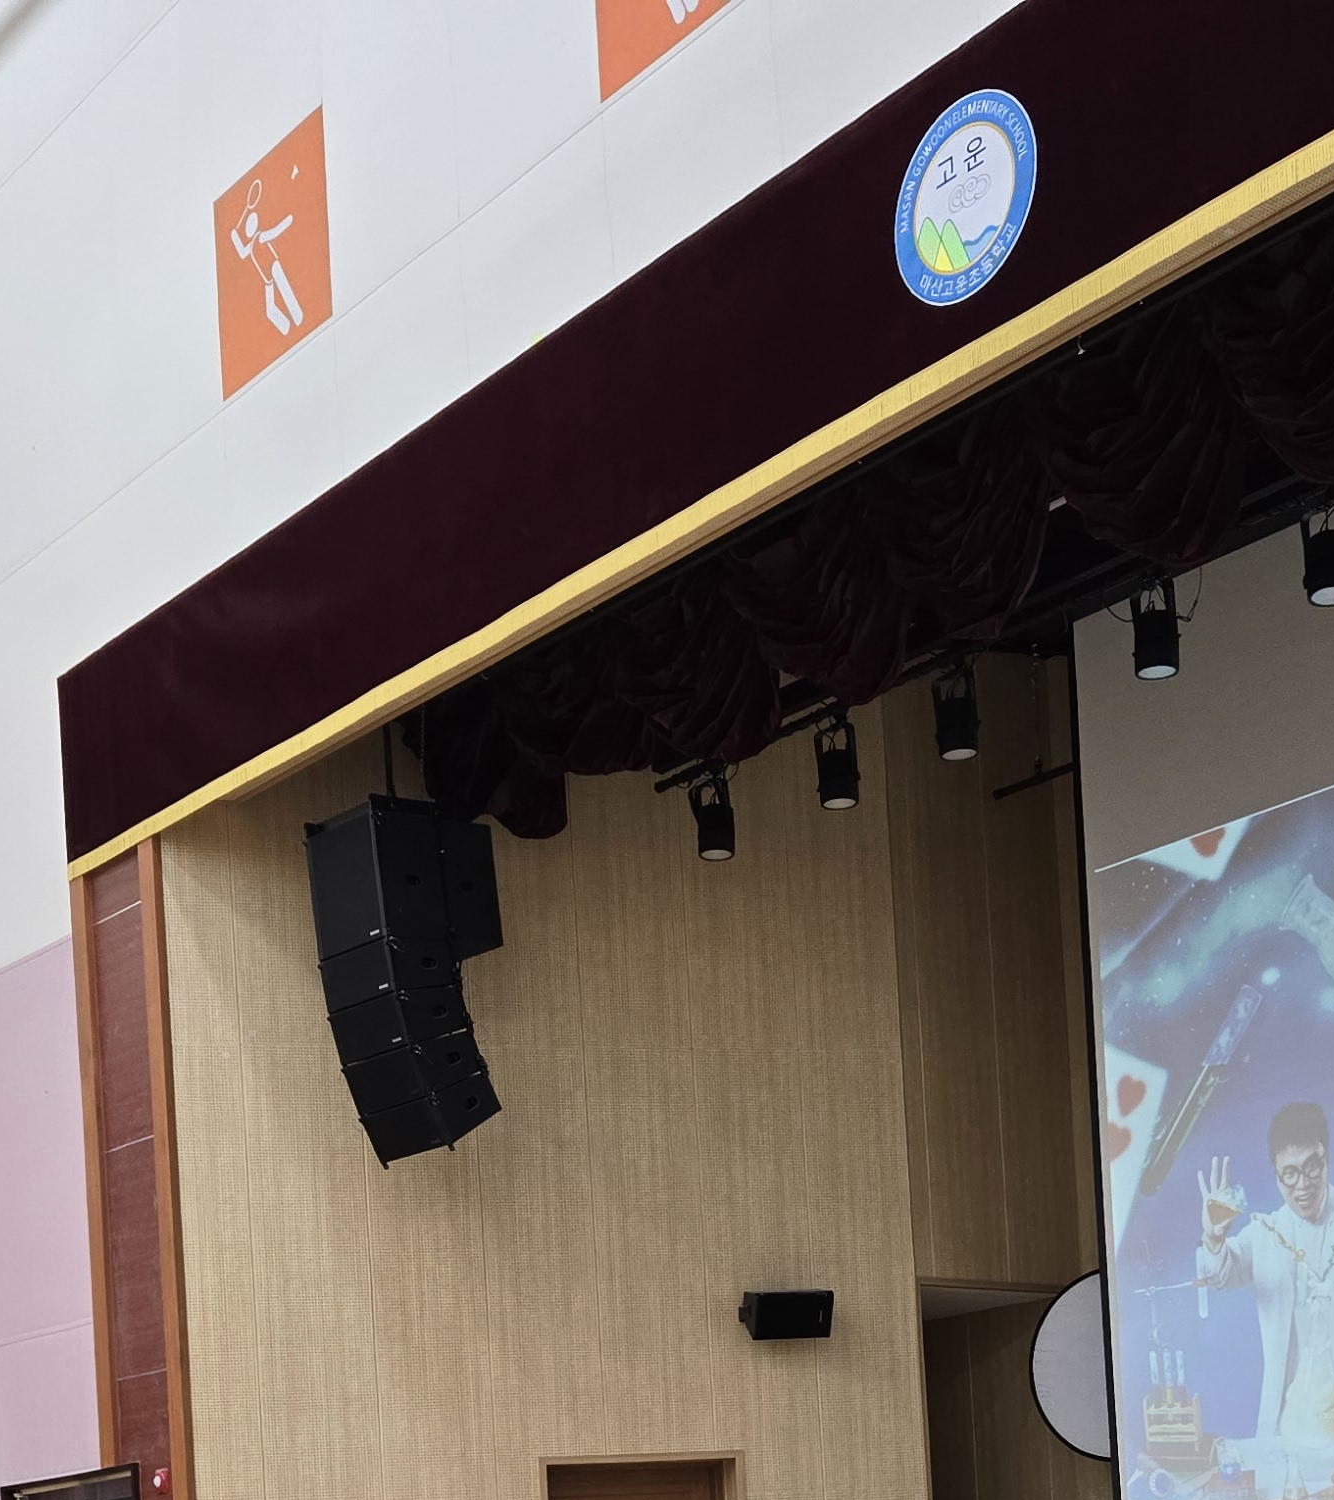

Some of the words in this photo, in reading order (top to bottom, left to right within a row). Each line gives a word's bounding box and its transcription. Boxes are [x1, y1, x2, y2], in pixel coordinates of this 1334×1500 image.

[900, 181, 917, 233] MASAN
[913, 119, 952, 176] GOWOON
[951, 99, 1009, 126] ELEMENTARY
[1006, 113, 1029, 161] SCHOOL
[936, 136, 986, 190] 고운
[919, 222, 1017, 297] 마산고운초등학교
